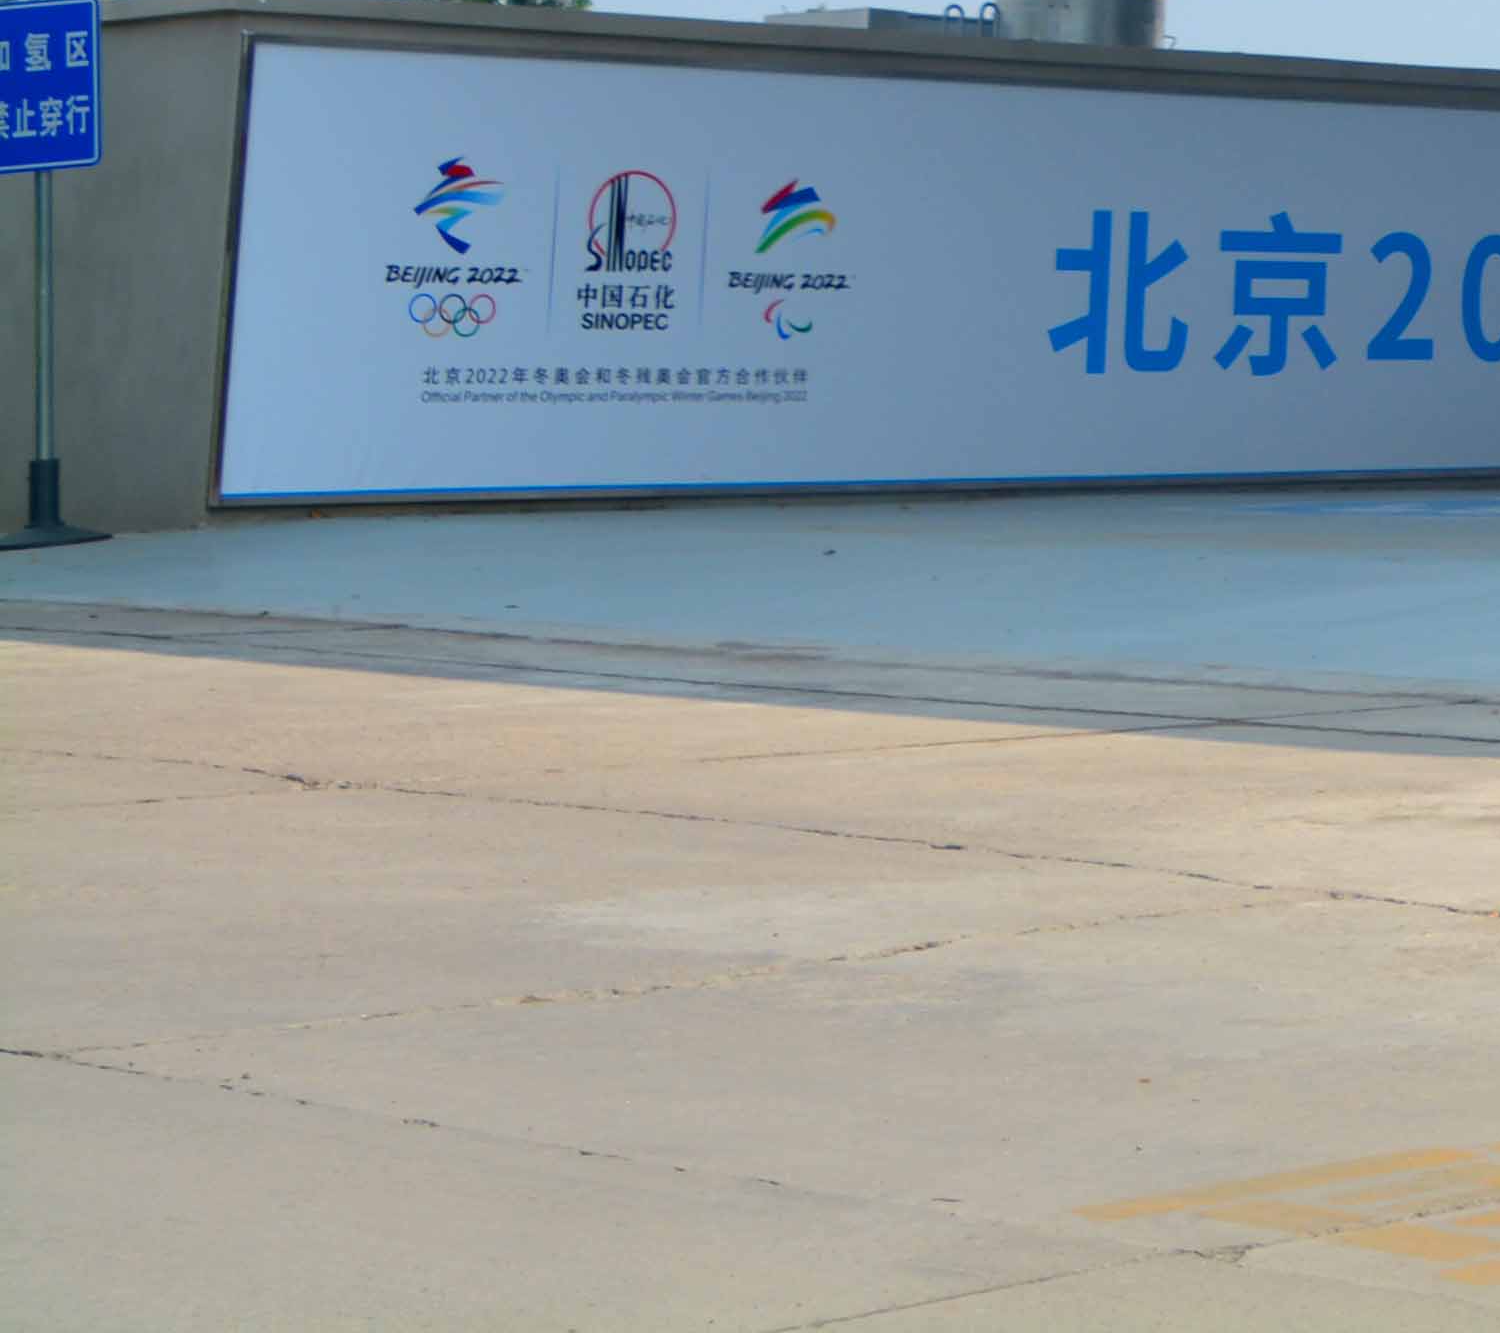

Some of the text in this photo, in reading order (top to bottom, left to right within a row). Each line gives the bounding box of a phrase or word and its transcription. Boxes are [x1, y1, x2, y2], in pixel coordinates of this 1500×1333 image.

[385, 264, 523, 289] BEIJING 2022
[728, 271, 852, 295] BEIJING 2022
[577, 283, 675, 310] 中国石化
[580, 312, 669, 331] SINOPEC
